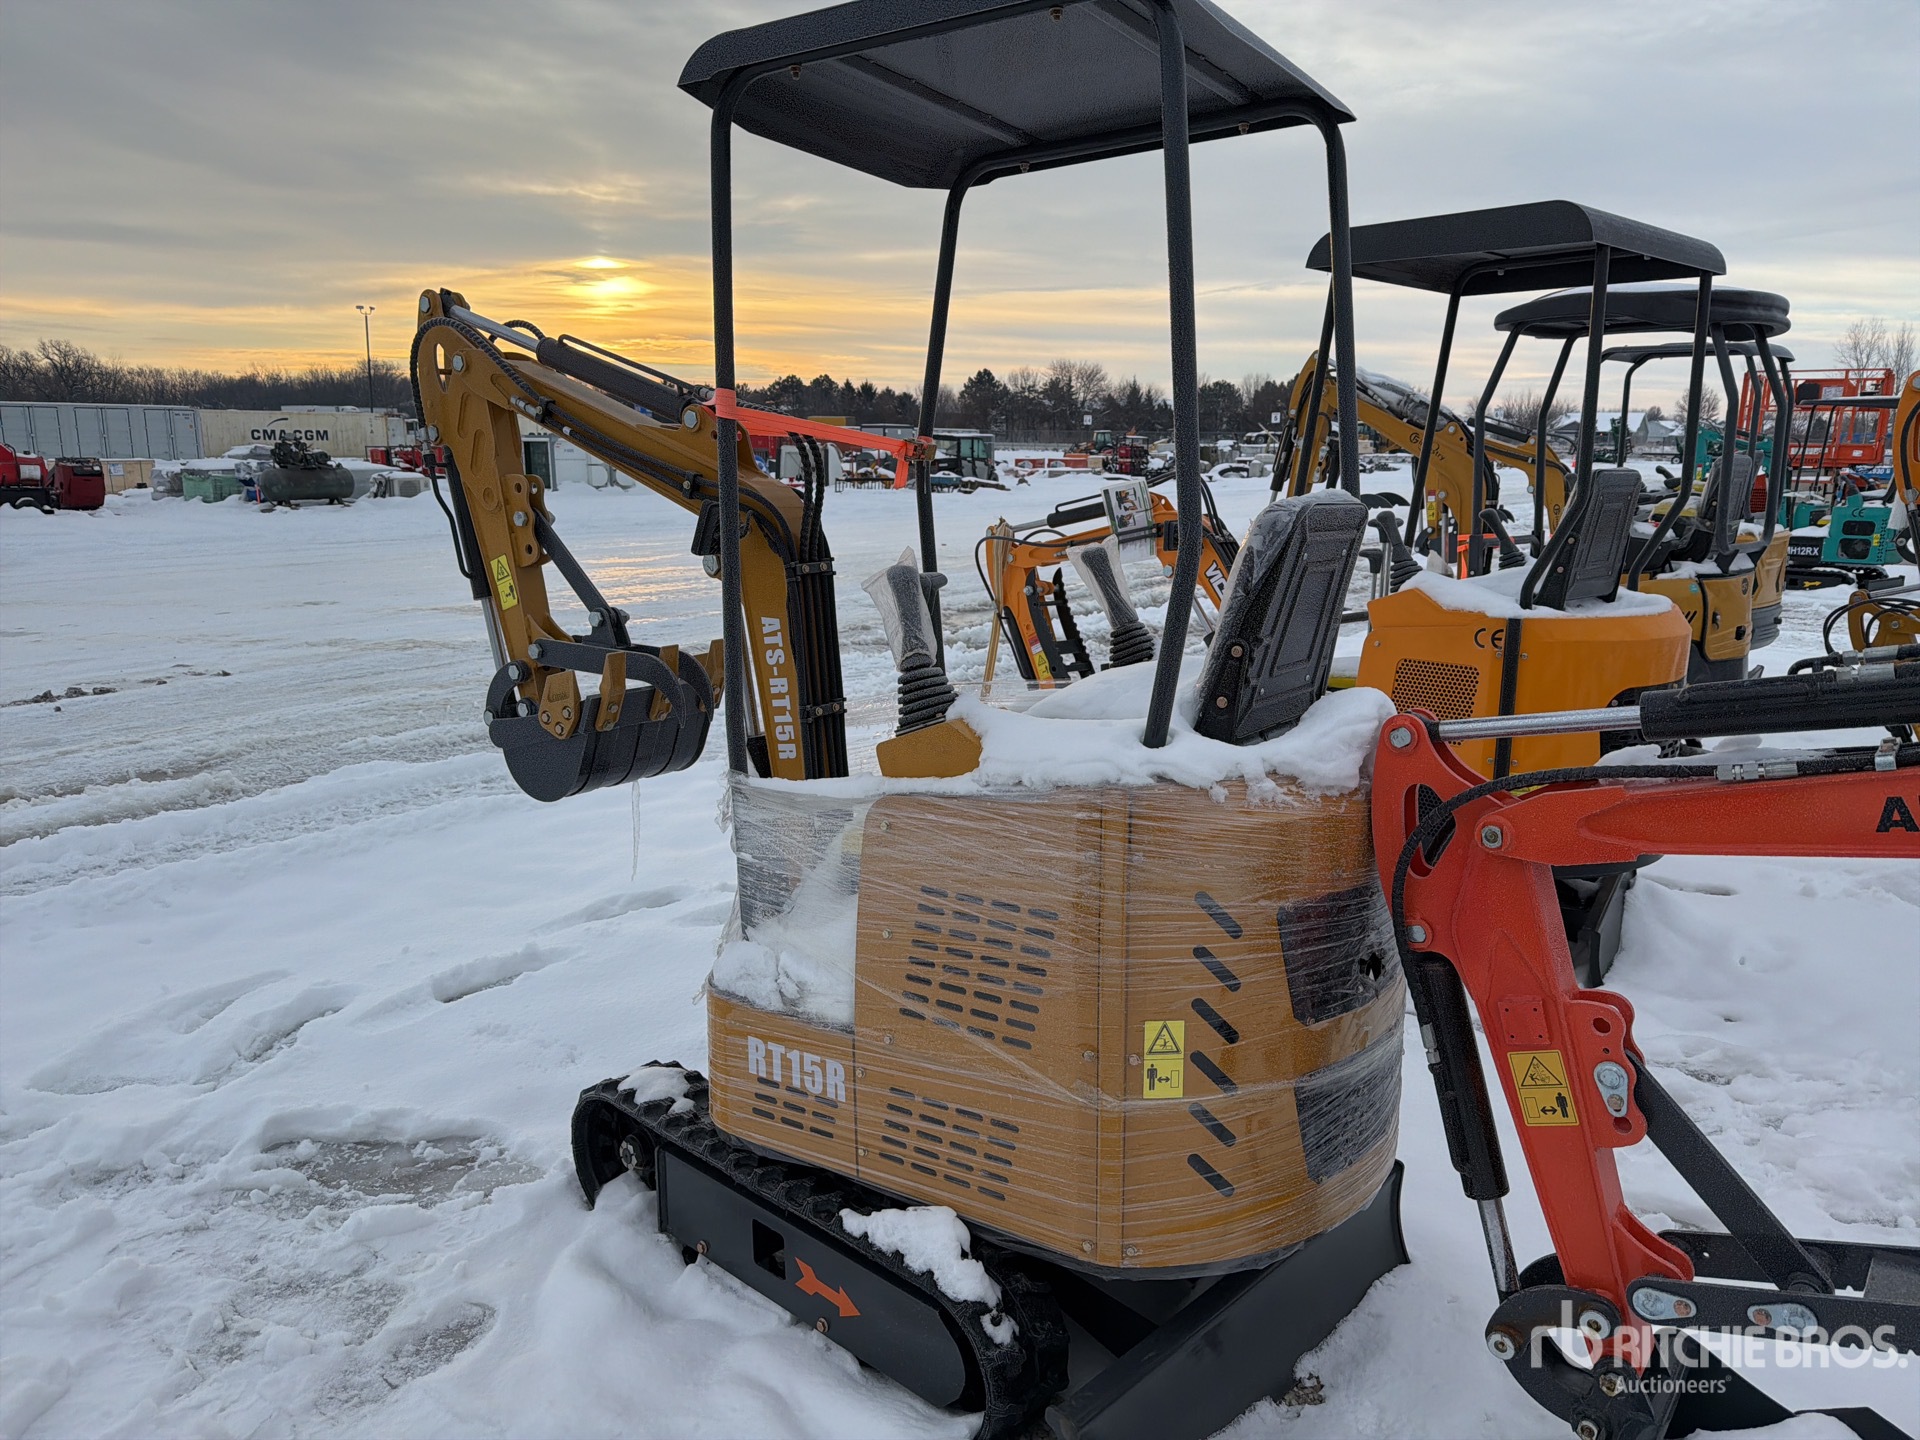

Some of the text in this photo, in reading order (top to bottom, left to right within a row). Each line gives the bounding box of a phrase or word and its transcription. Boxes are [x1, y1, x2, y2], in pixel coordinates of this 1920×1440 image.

[294, 430, 329, 441] CGM
[761, 616, 797, 760] ATS-RT15R
[747, 1036, 846, 1102] RT15R
